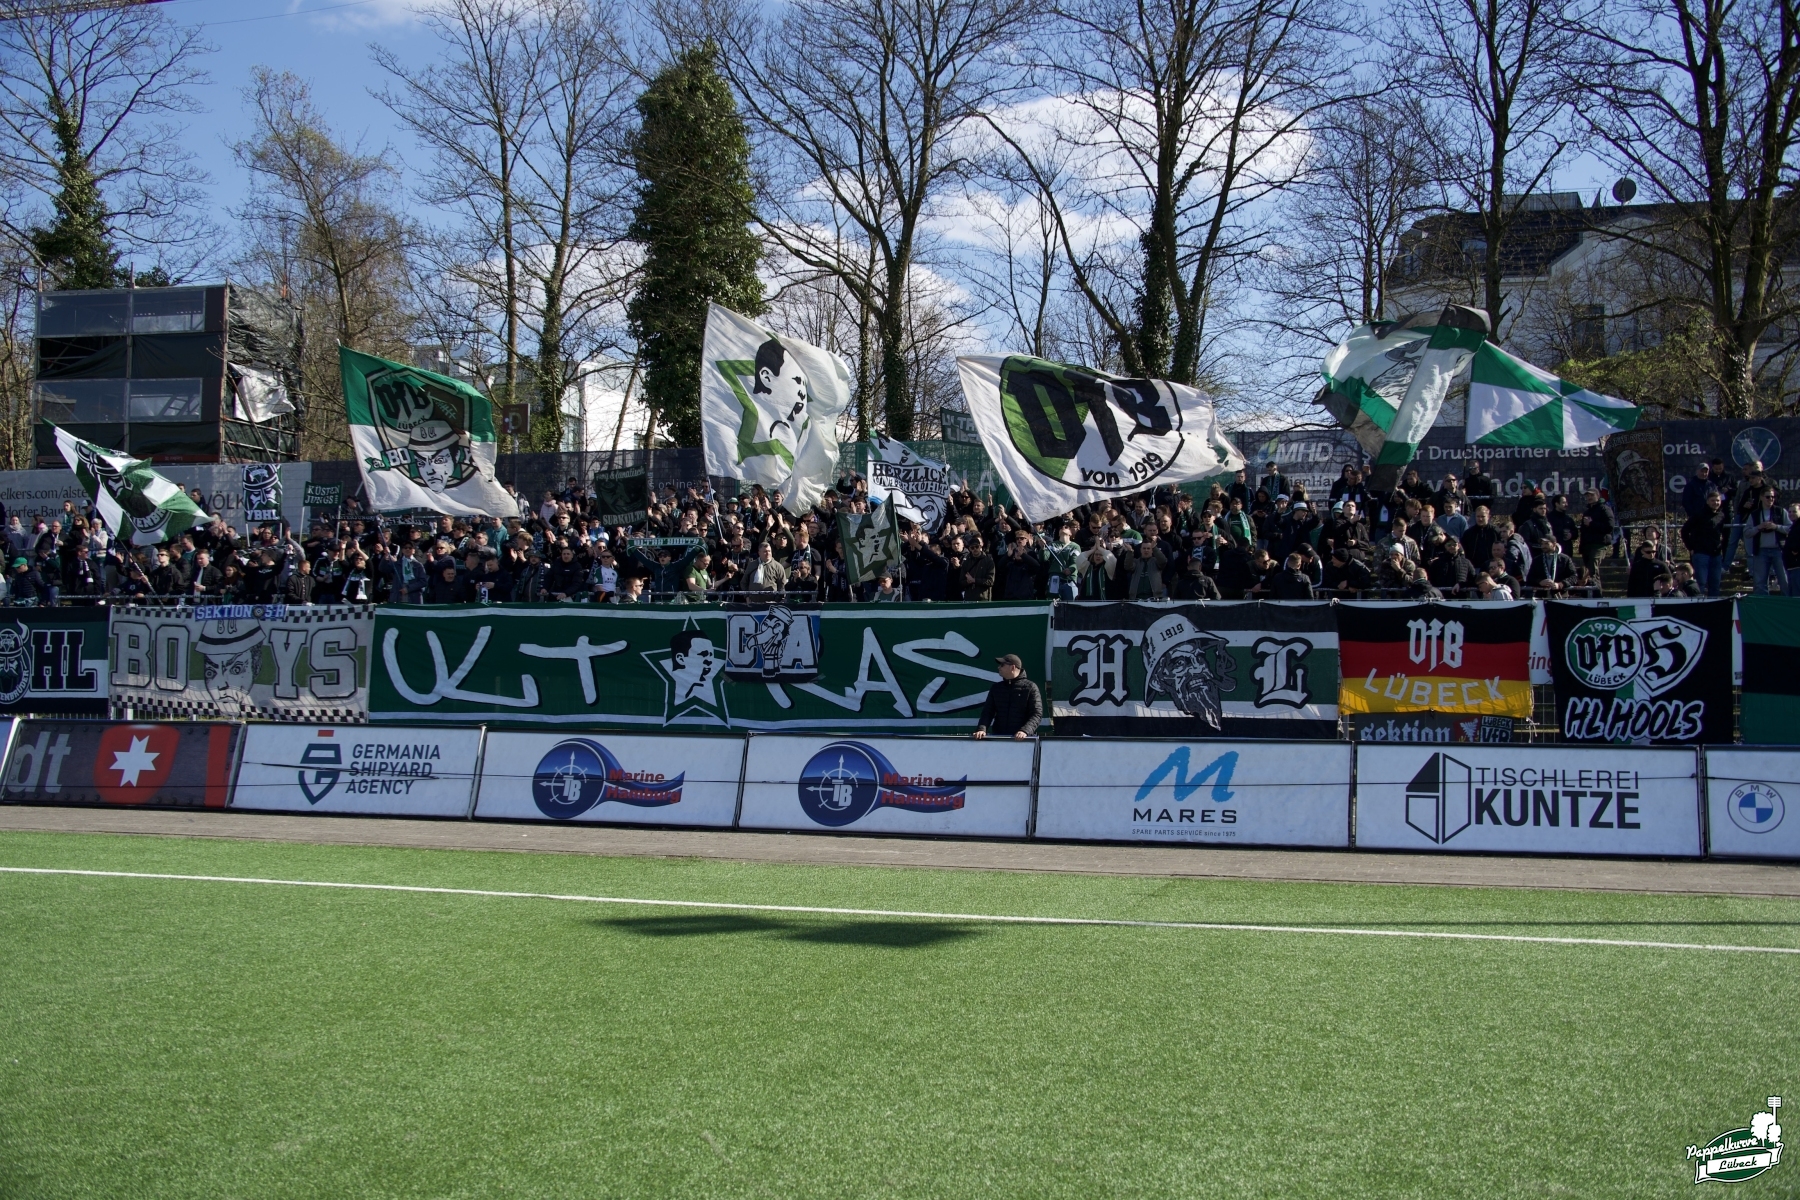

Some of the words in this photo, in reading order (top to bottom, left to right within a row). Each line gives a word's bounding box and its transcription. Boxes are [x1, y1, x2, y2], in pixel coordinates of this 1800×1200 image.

[1274, 441, 1334, 462] MHD
[1428, 445, 1550, 463] Druckpartner
[1081, 466, 1120, 486] von
[1128, 451, 1164, 483] 1919
[203, 490, 242, 509] VÖLK
[308, 485, 340, 497] KÜSTEN
[196, 605, 252, 619] SEKTION
[1160, 622, 1185, 642] 1919
[1588, 622, 1617, 633] 1919
[31, 630, 97, 692] HL
[1363, 667, 1504, 706] LÜBECK
[1588, 673, 1626, 685] LÜBECK
[1482, 717, 1511, 727] LÜBECK
[1604, 697, 1704, 741] HOOLS
[352, 744, 441, 760] GERMANIA
[349, 761, 432, 777] SHIPYARD
[608, 769, 665, 782] Marine
[345, 778, 414, 795] AGENCY
[883, 773, 945, 787] Marine
[1475, 767, 1639, 790] TISCHLEREI
[605, 786, 681, 803] Hamburg
[881, 790, 964, 809] Hamburg
[1735, 784, 1777, 799] BMW
[1133, 808, 1237, 824] MARES
[1475, 789, 1641, 830] KUNTZE
